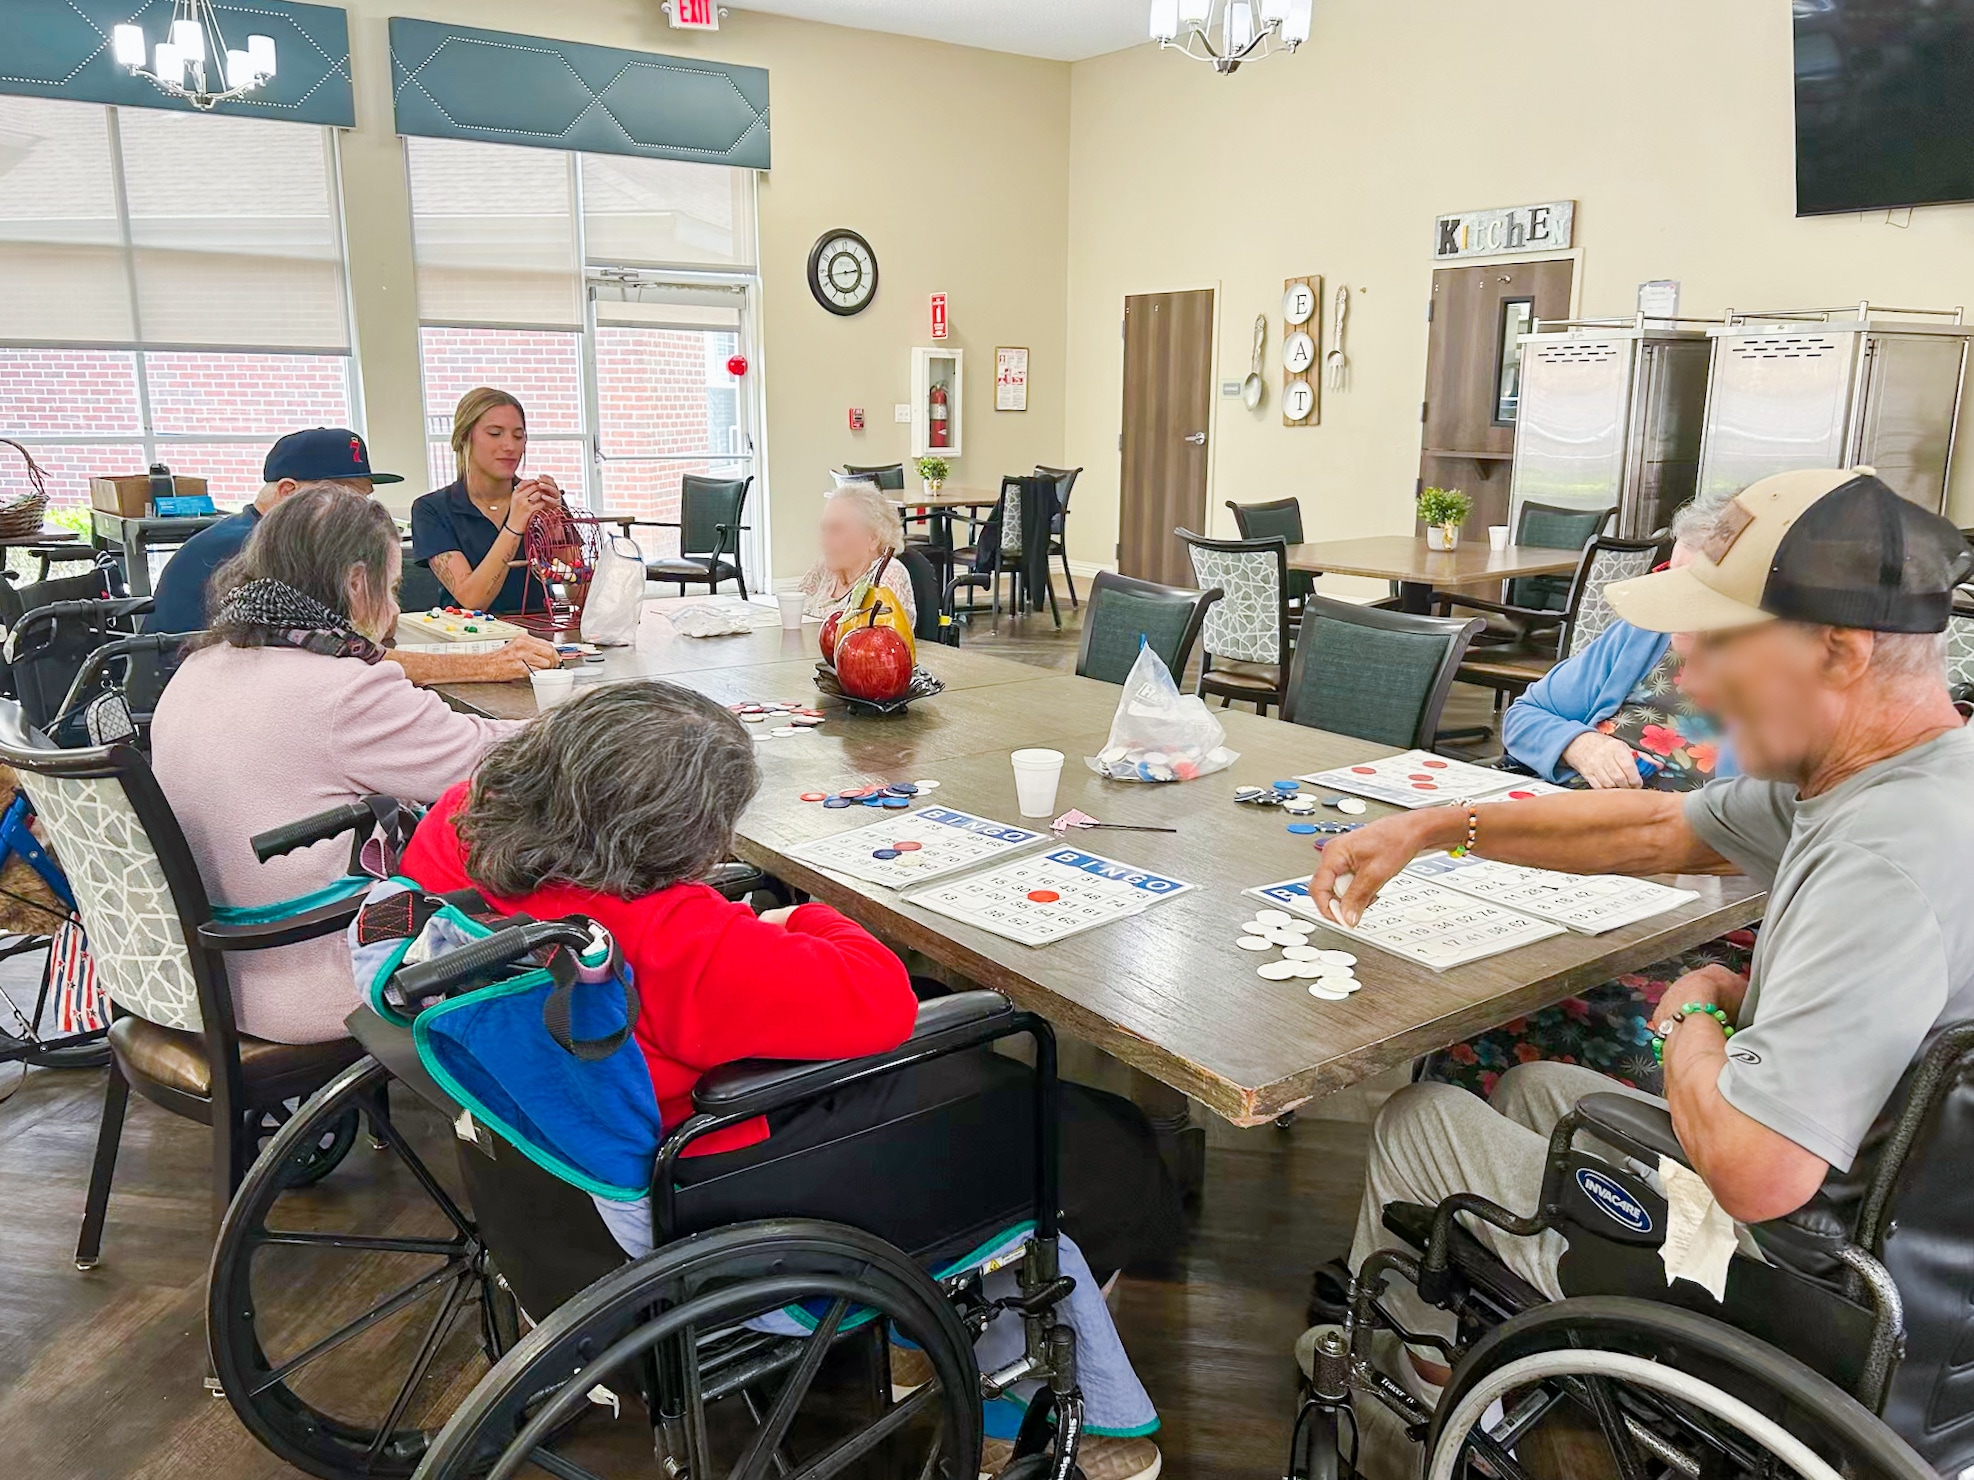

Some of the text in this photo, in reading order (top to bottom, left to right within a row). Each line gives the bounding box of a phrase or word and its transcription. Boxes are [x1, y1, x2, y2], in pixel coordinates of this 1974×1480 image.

[679, 0, 710, 24] EXIT
[924, 810, 1025, 840] BINGO
[1056, 850, 1170, 892] BINGO
[966, 885, 984, 893] 12
[1010, 901, 1031, 909] 35
[1034, 909, 1055, 917] 54
[991, 877, 1008, 885] 15
[1058, 901, 1078, 909] 51
[1082, 908, 1102, 916] 61
[1037, 877, 1055, 885] 16
[1106, 900, 1126, 908] 74
[1129, 891, 1149, 899] 73
[1372, 900, 1395, 908] 31
[1569, 913, 1589, 921] 13
[1606, 901, 1626, 909] 31
[1624, 894, 1645, 902] 52
[1640, 888, 1661, 896] 73
[1008, 918, 1029, 926] 52
[1032, 925, 1054, 934] 72
[1380, 917, 1402, 925] 23
[1409, 928, 1430, 936] 19
[1432, 921, 1454, 929] 34
[1476, 909, 1498, 917] 74
[1466, 933, 1485, 941] 41
[1585, 1178, 1641, 1219] INVACARE
[1381, 1377, 1406, 1397] Tracer
[1066, 1417, 1077, 1454] Silver
